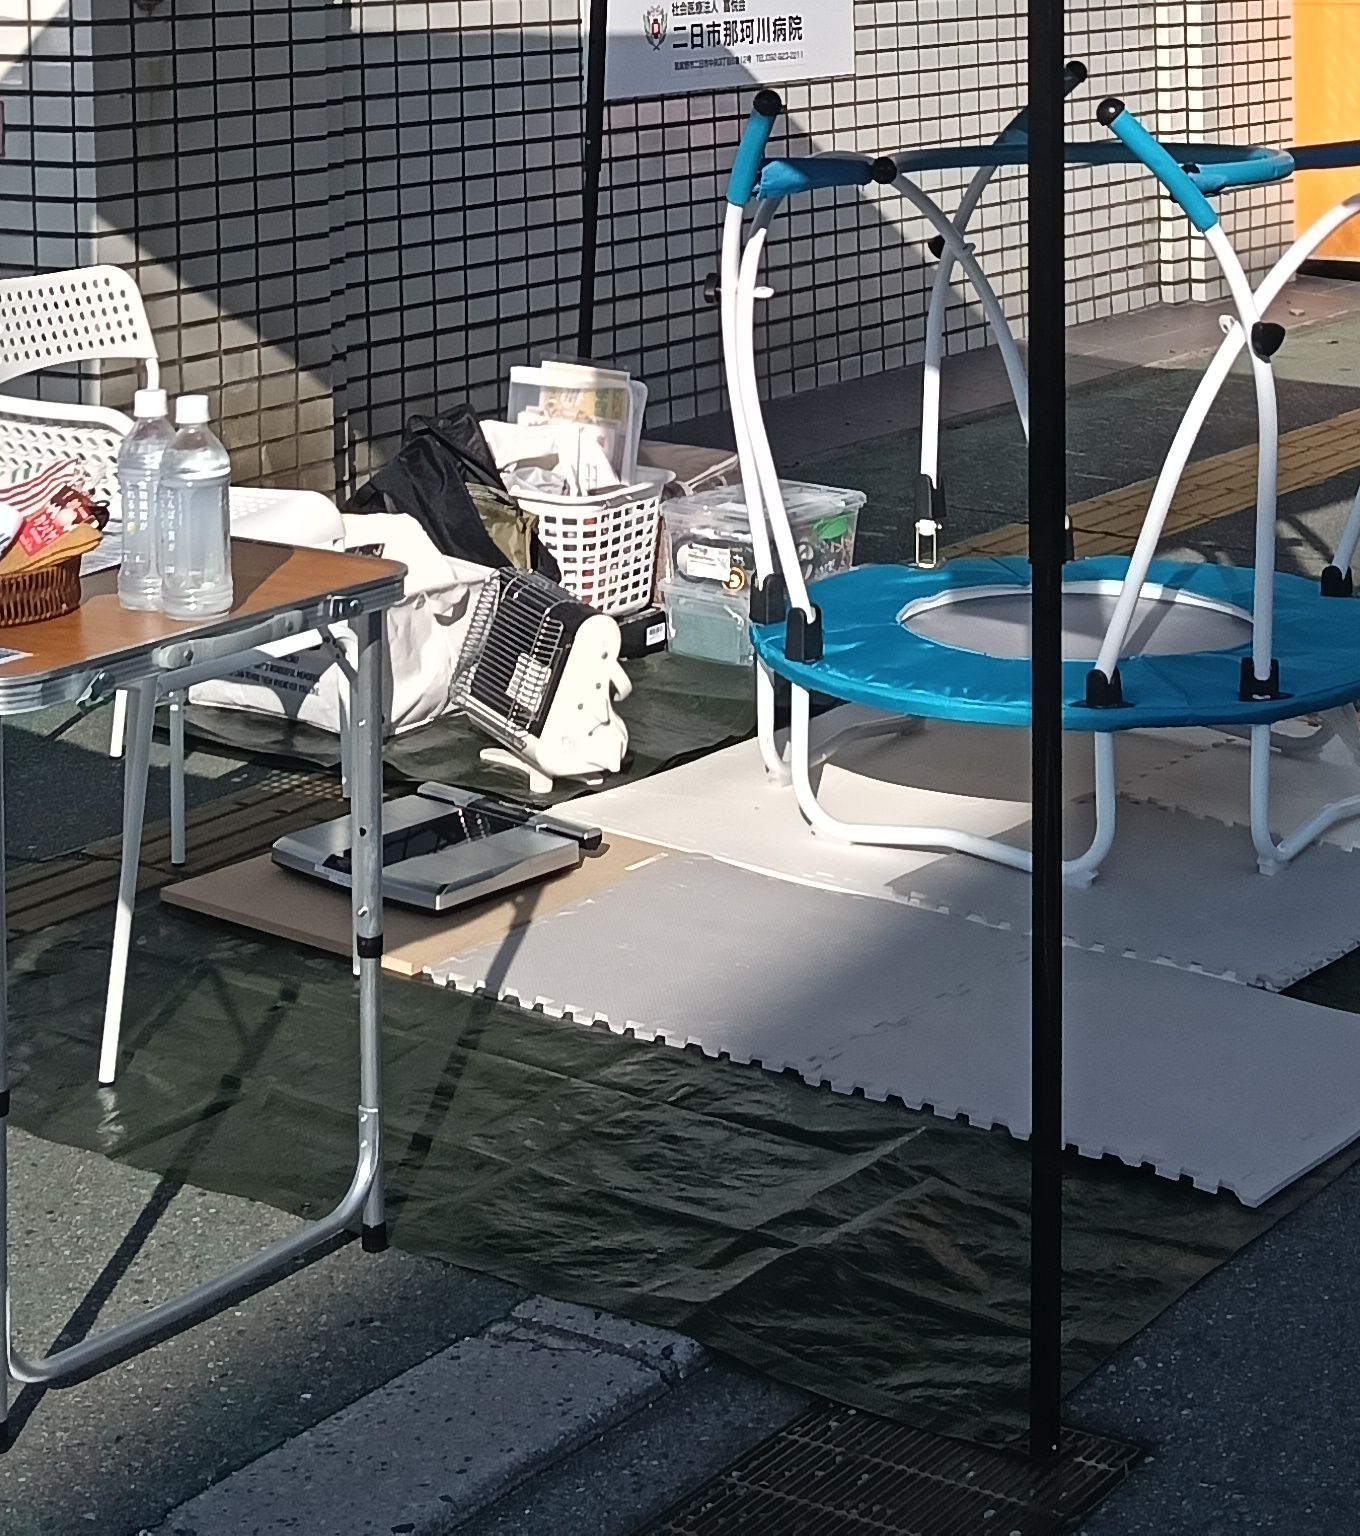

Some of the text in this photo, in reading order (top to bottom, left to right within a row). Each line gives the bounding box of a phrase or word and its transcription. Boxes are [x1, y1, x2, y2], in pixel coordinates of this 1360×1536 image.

[672, 15, 803, 50] 二日市那珂川病院
